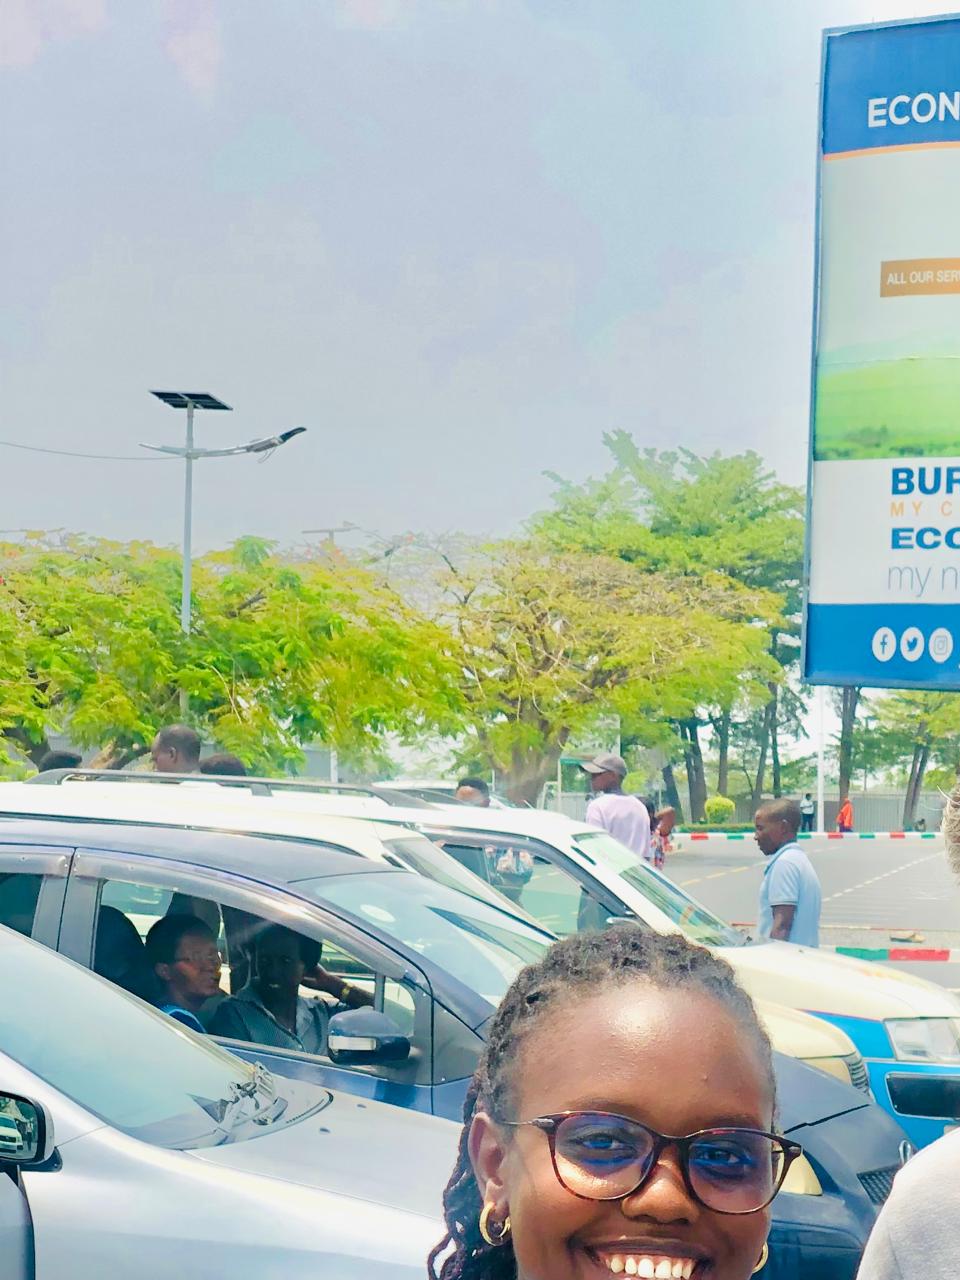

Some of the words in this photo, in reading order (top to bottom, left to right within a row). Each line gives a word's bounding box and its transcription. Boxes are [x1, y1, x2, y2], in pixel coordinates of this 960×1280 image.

[887, 273, 907, 285] ALL
[910, 271, 934, 284] OUR
[890, 501, 923, 518] MY
[887, 565, 932, 598] my
